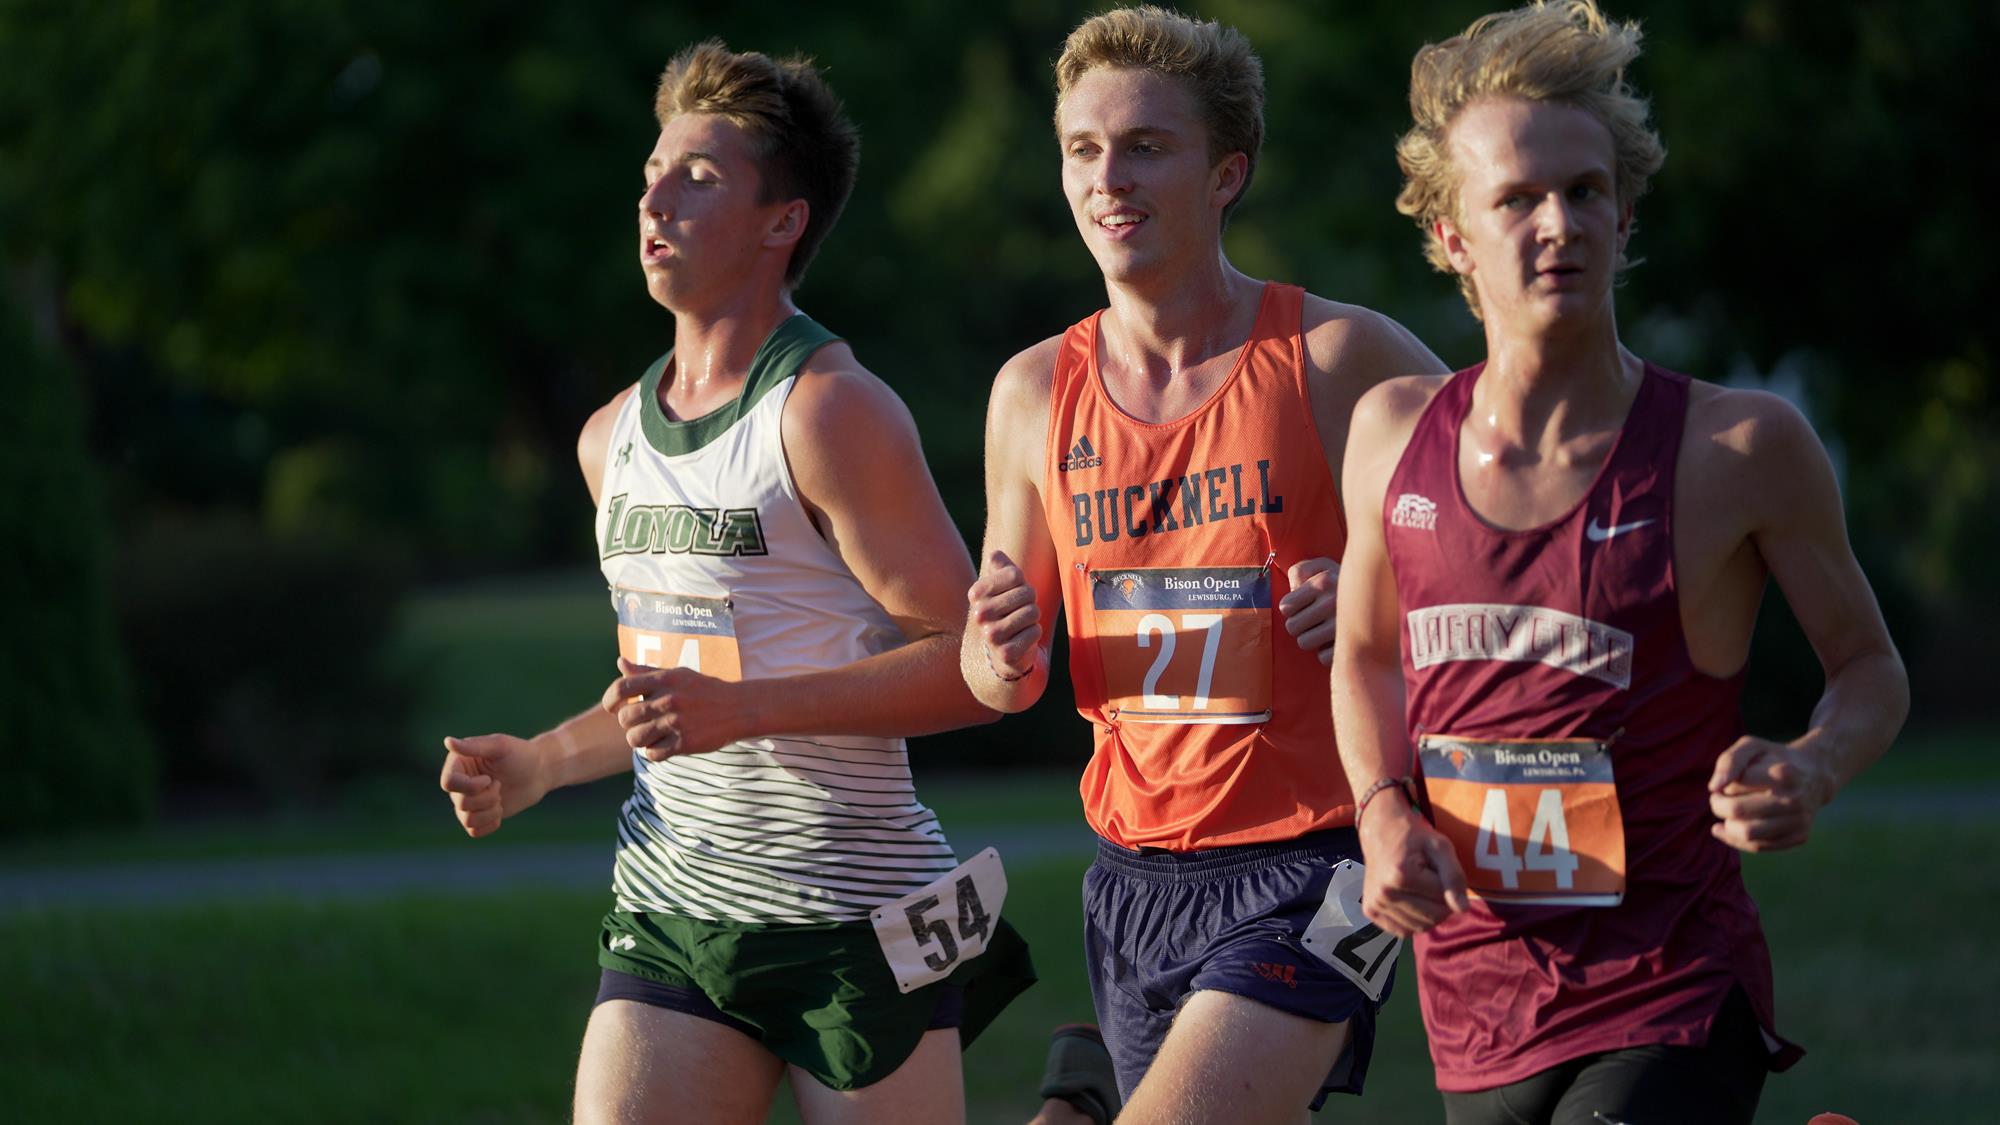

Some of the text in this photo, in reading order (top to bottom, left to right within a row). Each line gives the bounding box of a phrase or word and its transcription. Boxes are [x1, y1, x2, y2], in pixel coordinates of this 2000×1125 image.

[1058, 454, 1103, 473] adidas
[603, 493, 768, 560] LOYOLA
[1072, 459, 1283, 547] BUCKNELL
[655, 601, 713, 619] Bison Open
[1164, 576, 1240, 592] Bison Open
[1188, 593, 1232, 602] LEWISBURG,
[1137, 613, 1223, 709] 27
[1411, 609, 1629, 680] LAFAYETTE
[1494, 749, 1537, 766] Bison
[1538, 749, 1580, 767] Open
[1475, 789, 1580, 889] 44
[904, 874, 991, 972] 54
